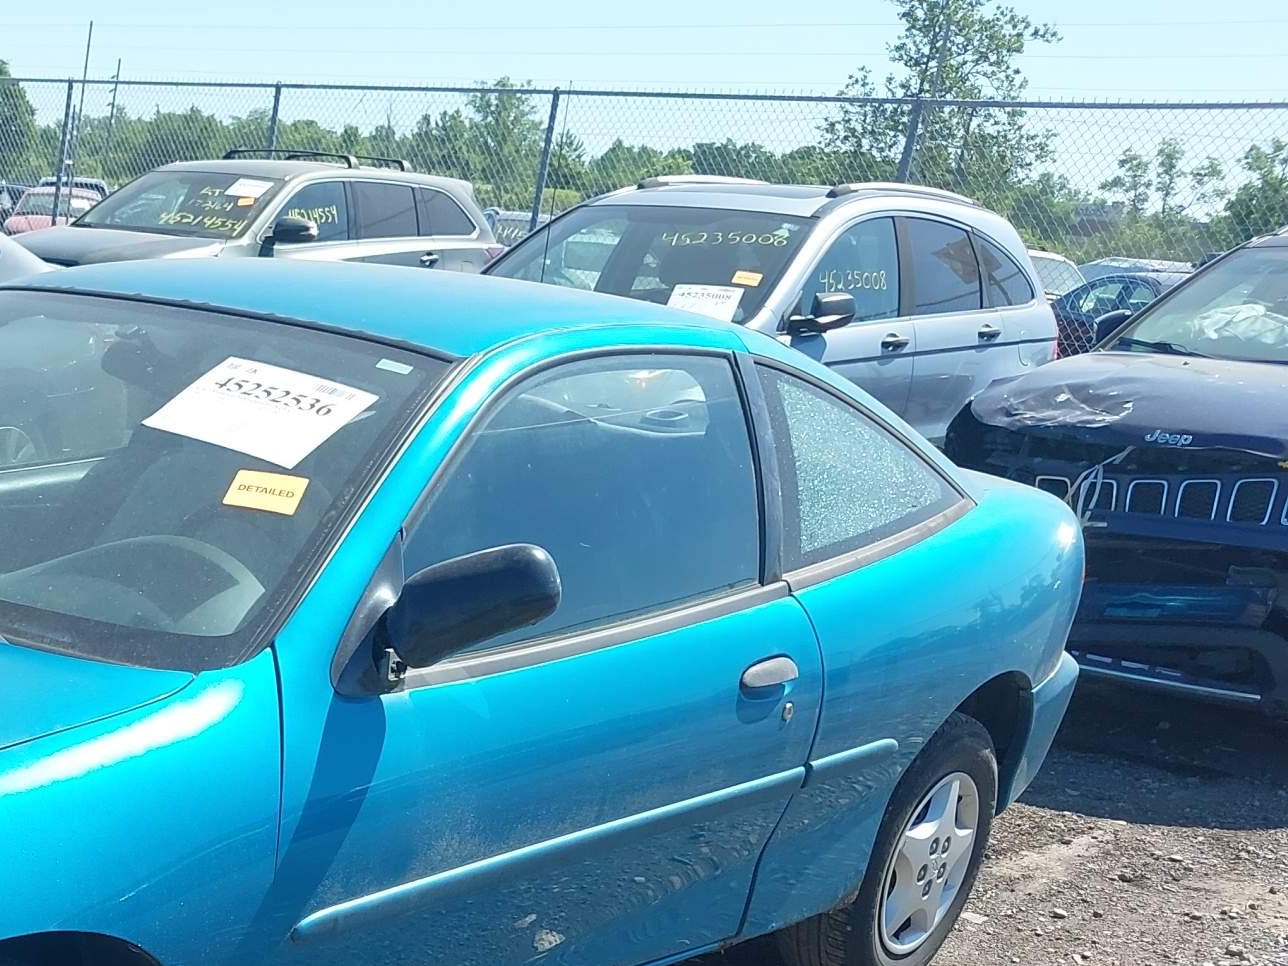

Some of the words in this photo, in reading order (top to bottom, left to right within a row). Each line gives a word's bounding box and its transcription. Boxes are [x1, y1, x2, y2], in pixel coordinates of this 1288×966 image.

[818, 269, 888, 294] 45235008
[214, 376, 337, 417] 45252536
[1144, 429, 1193, 447] Jeep
[237, 483, 295, 499] DETAILED
